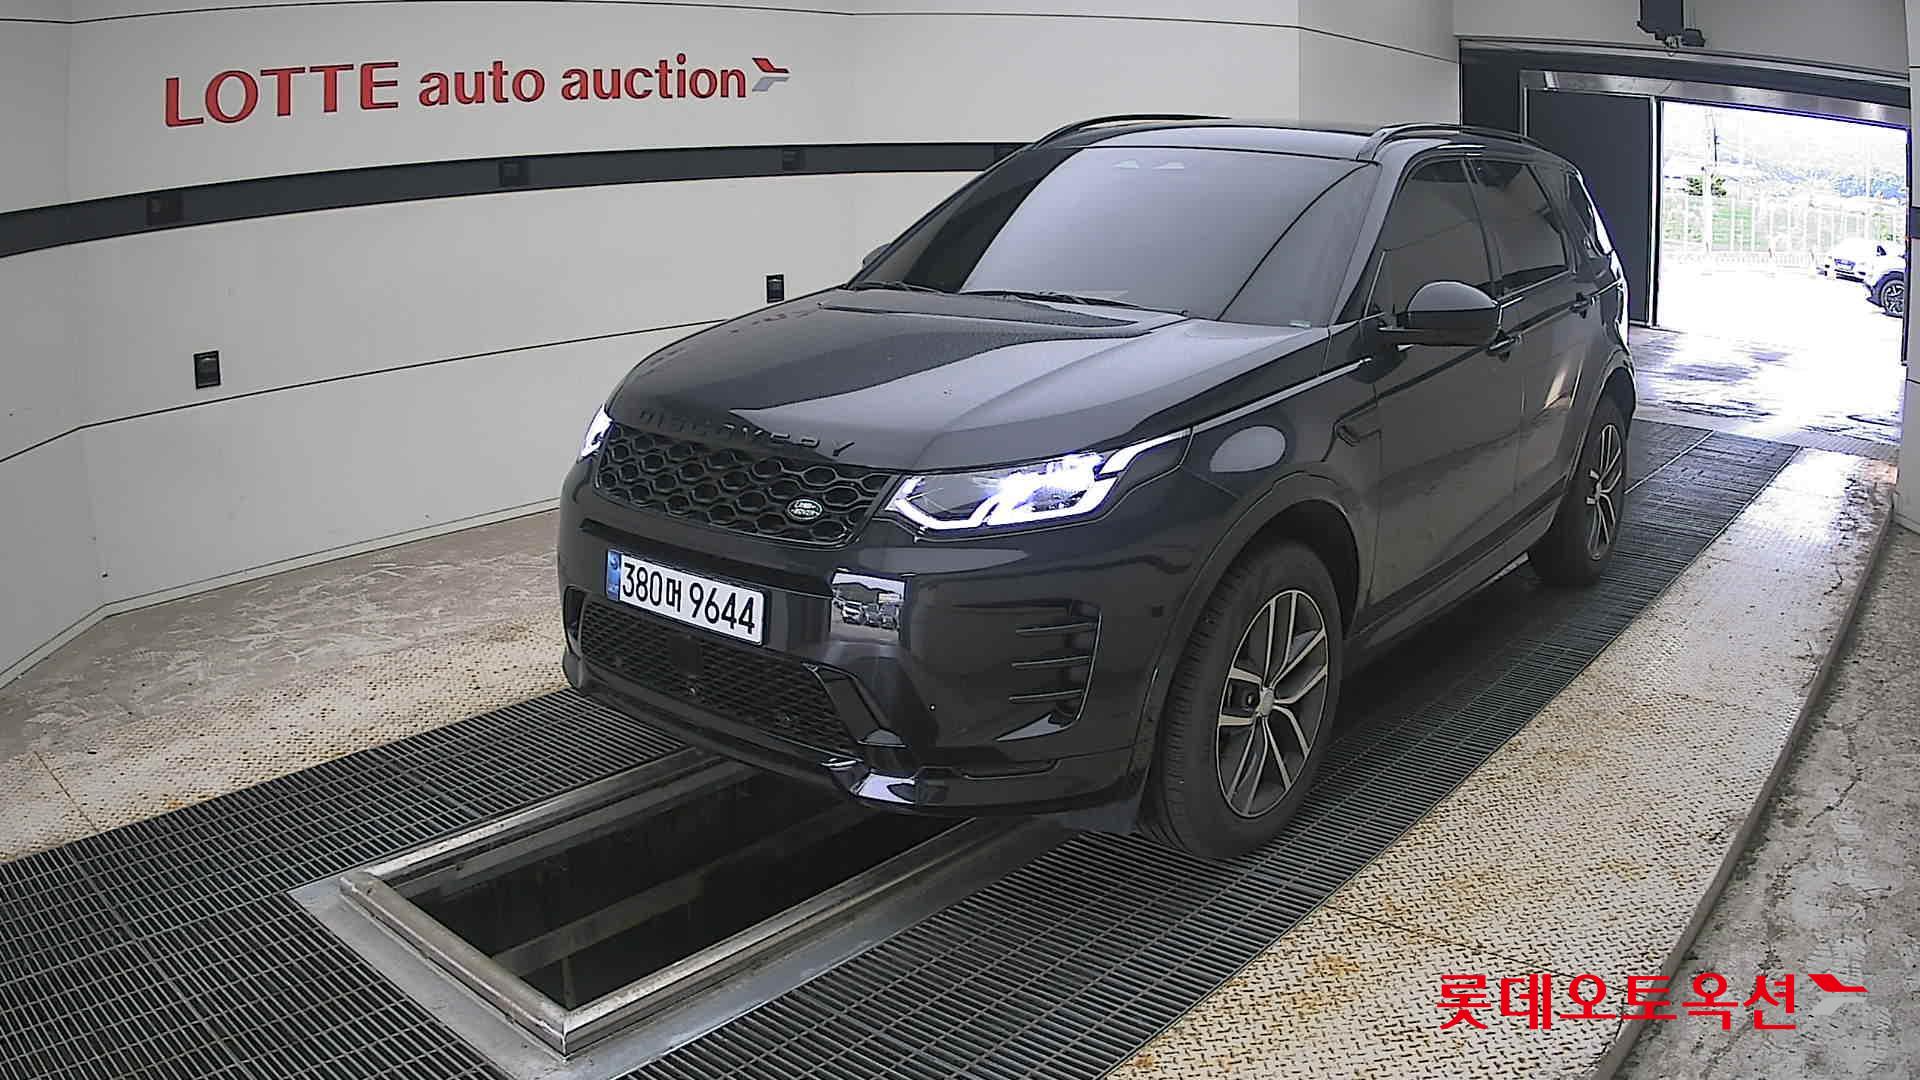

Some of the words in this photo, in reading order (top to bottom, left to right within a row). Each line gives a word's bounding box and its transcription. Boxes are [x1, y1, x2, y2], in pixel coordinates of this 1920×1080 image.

[164, 61, 400, 129] LOTTE
[418, 59, 546, 107] auto
[561, 52, 748, 101] auction
[622, 562, 682, 612] 380머
[689, 582, 756, 635] 9644
